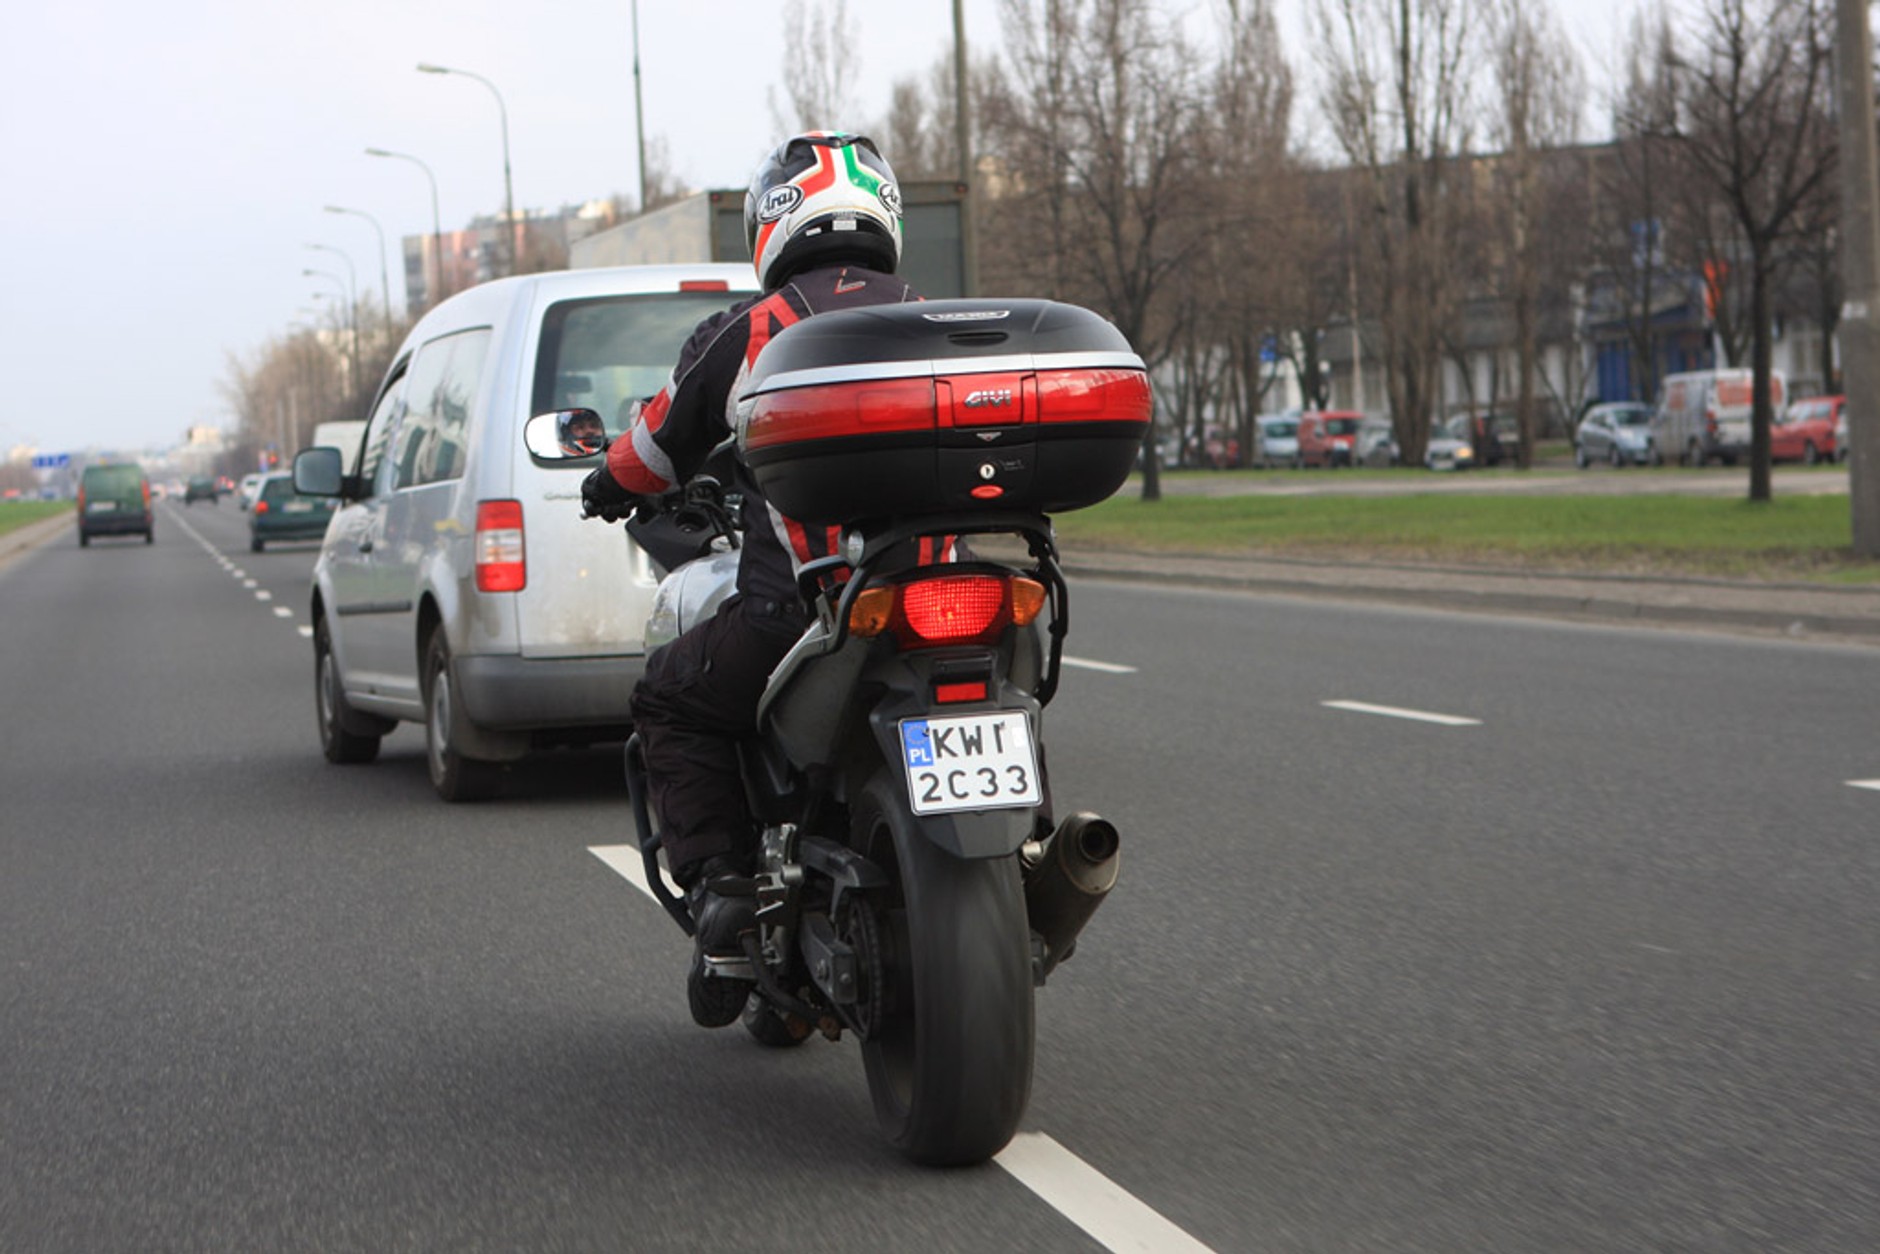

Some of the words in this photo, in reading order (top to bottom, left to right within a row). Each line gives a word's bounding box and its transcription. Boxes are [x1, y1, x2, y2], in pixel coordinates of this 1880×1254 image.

[763, 189, 793, 212] Arai
[964, 389, 1011, 408] GIVI
[909, 748, 931, 763] PL
[919, 765, 1028, 803] 2C33
